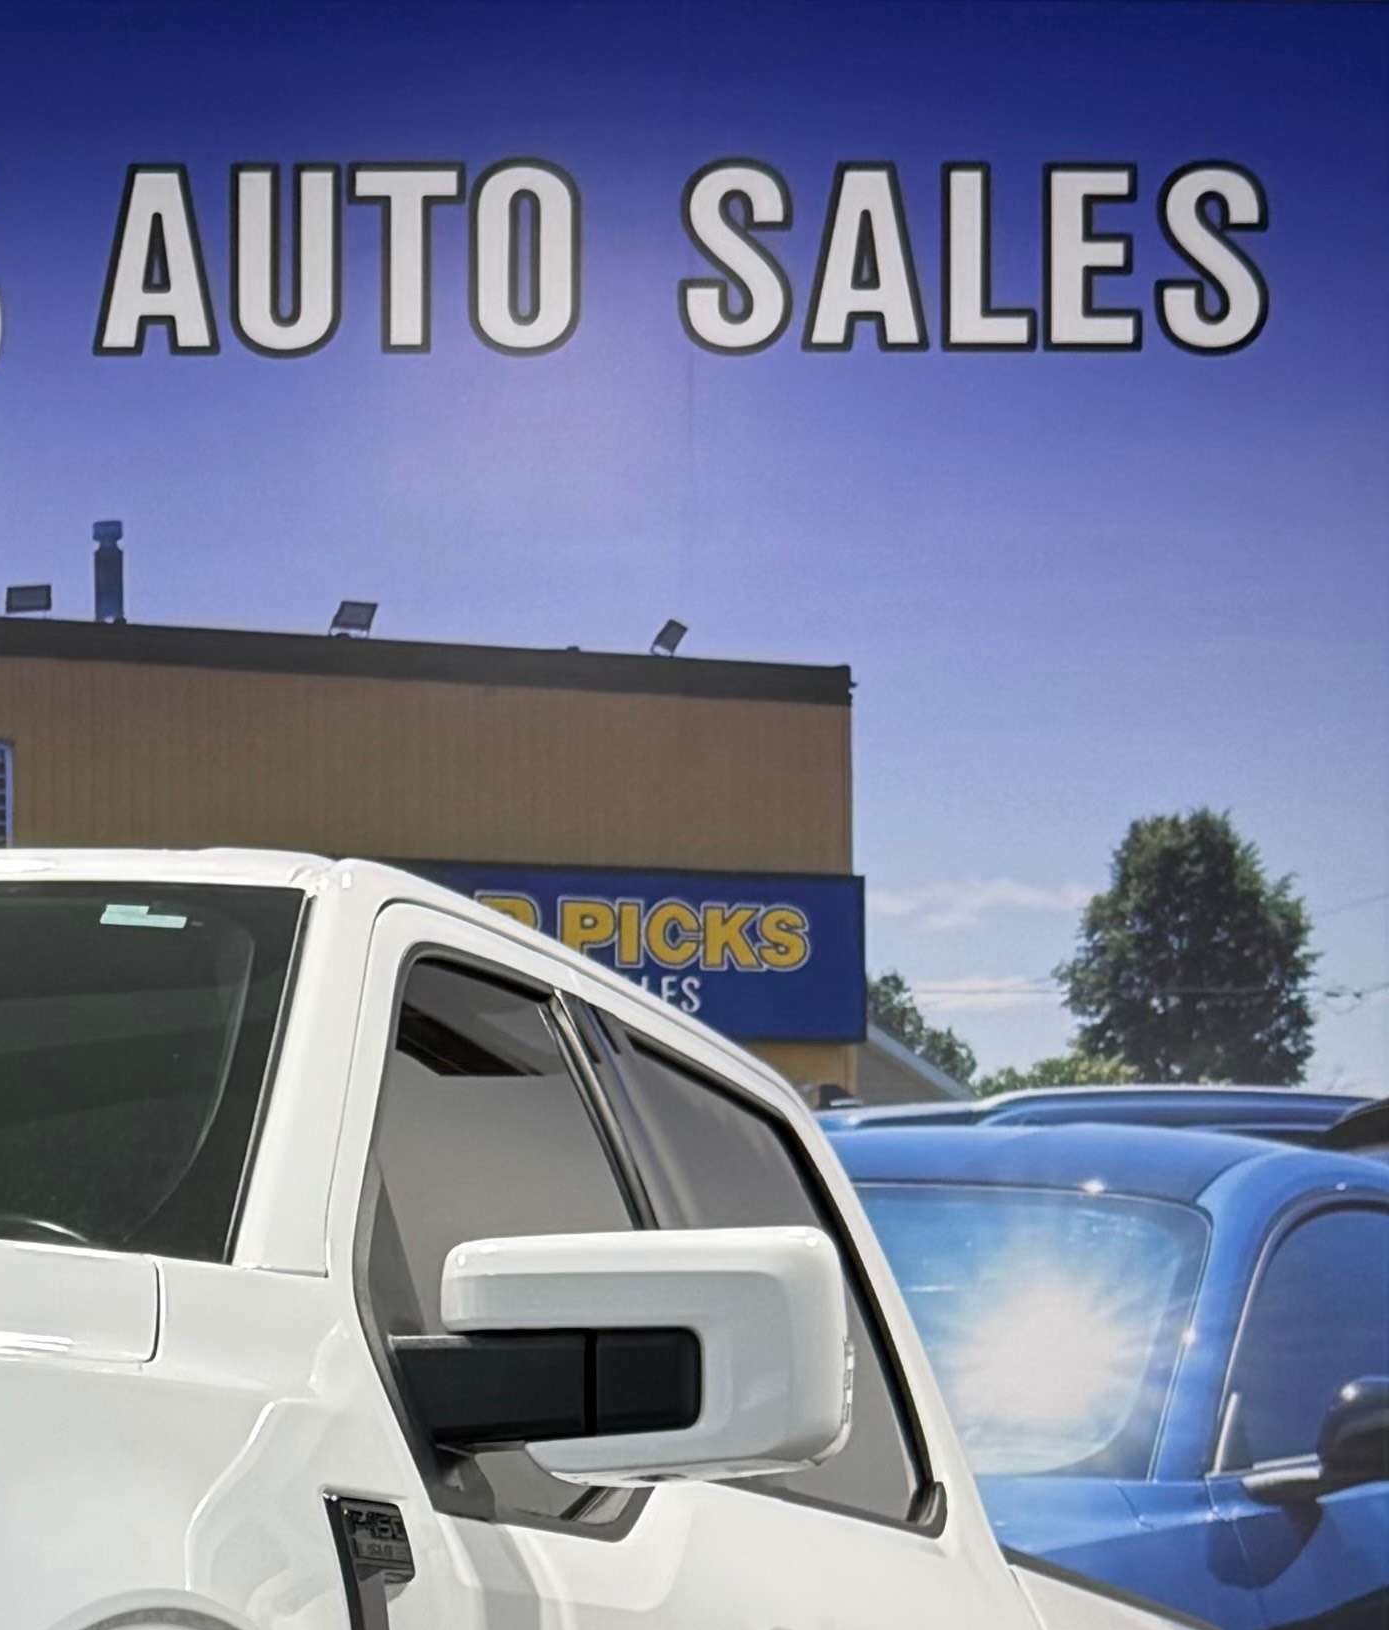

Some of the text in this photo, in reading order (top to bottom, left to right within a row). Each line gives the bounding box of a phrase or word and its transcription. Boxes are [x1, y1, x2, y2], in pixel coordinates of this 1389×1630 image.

[92, 157, 582, 358] AUTO
[679, 156, 1269, 355] SALES
[558, 896, 811, 972] PICKS
